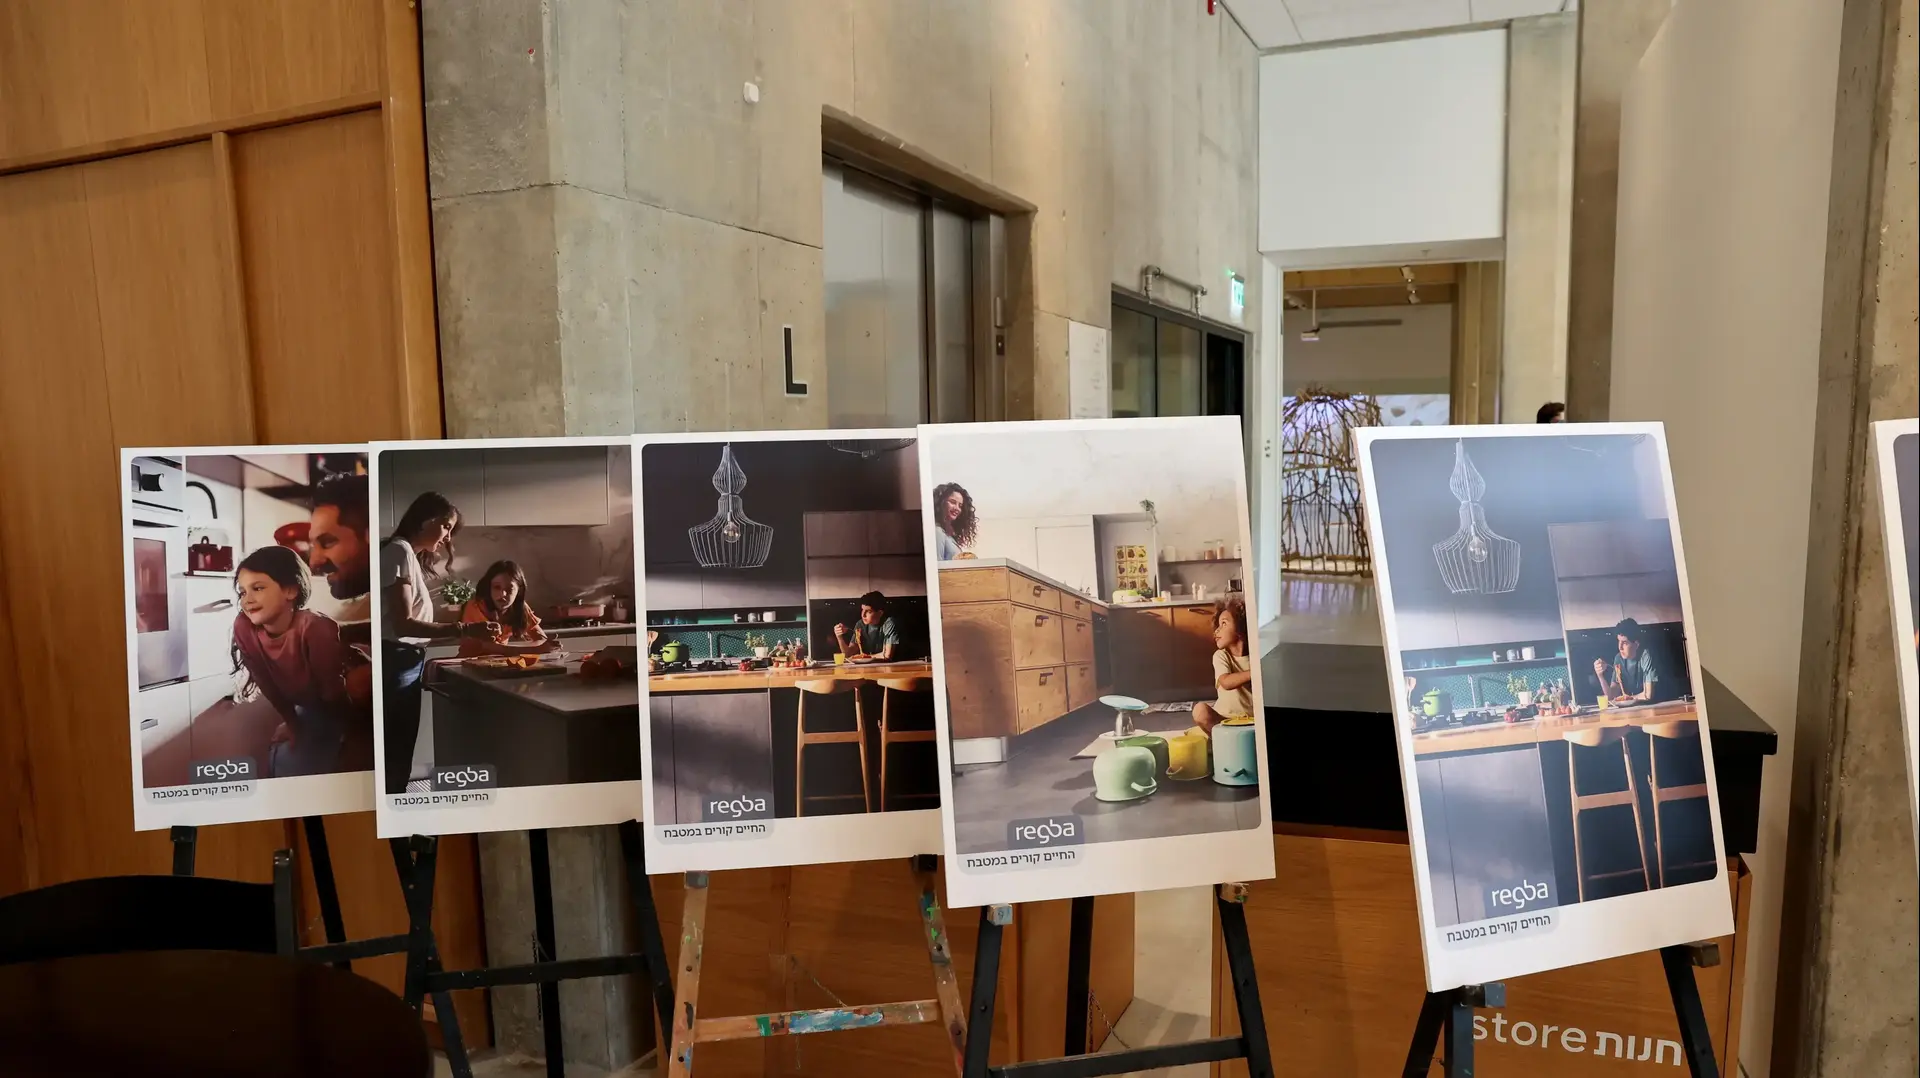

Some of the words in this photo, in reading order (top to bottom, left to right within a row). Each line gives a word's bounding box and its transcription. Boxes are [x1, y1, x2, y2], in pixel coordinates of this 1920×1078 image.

[783, 326, 807, 396] L
[196, 759, 250, 780] regba
[437, 766, 490, 788] regba
[152, 789, 189, 799] במטבח
[191, 787, 218, 796] קורים
[221, 784, 249, 793] החיים
[394, 797, 430, 805] במטבח
[432, 795, 458, 804] קורים
[461, 793, 489, 802] החיים
[710, 795, 766, 818] regba
[664, 828, 702, 838] במטבח
[705, 826, 733, 836] קורים
[736, 824, 766, 834] החיים
[1015, 819, 1075, 844] regba
[1010, 853, 1040, 864] קורים
[1043, 850, 1075, 862] החיים
[967, 857, 1007, 868] במטבח
[1491, 879, 1549, 910] regba
[1520, 915, 1551, 929] החיים
[1488, 921, 1518, 935] קורים
[1446, 926, 1486, 943] במטבח
[1472, 1012, 1588, 1053] store
[1593, 1030, 1683, 1067] חנות
